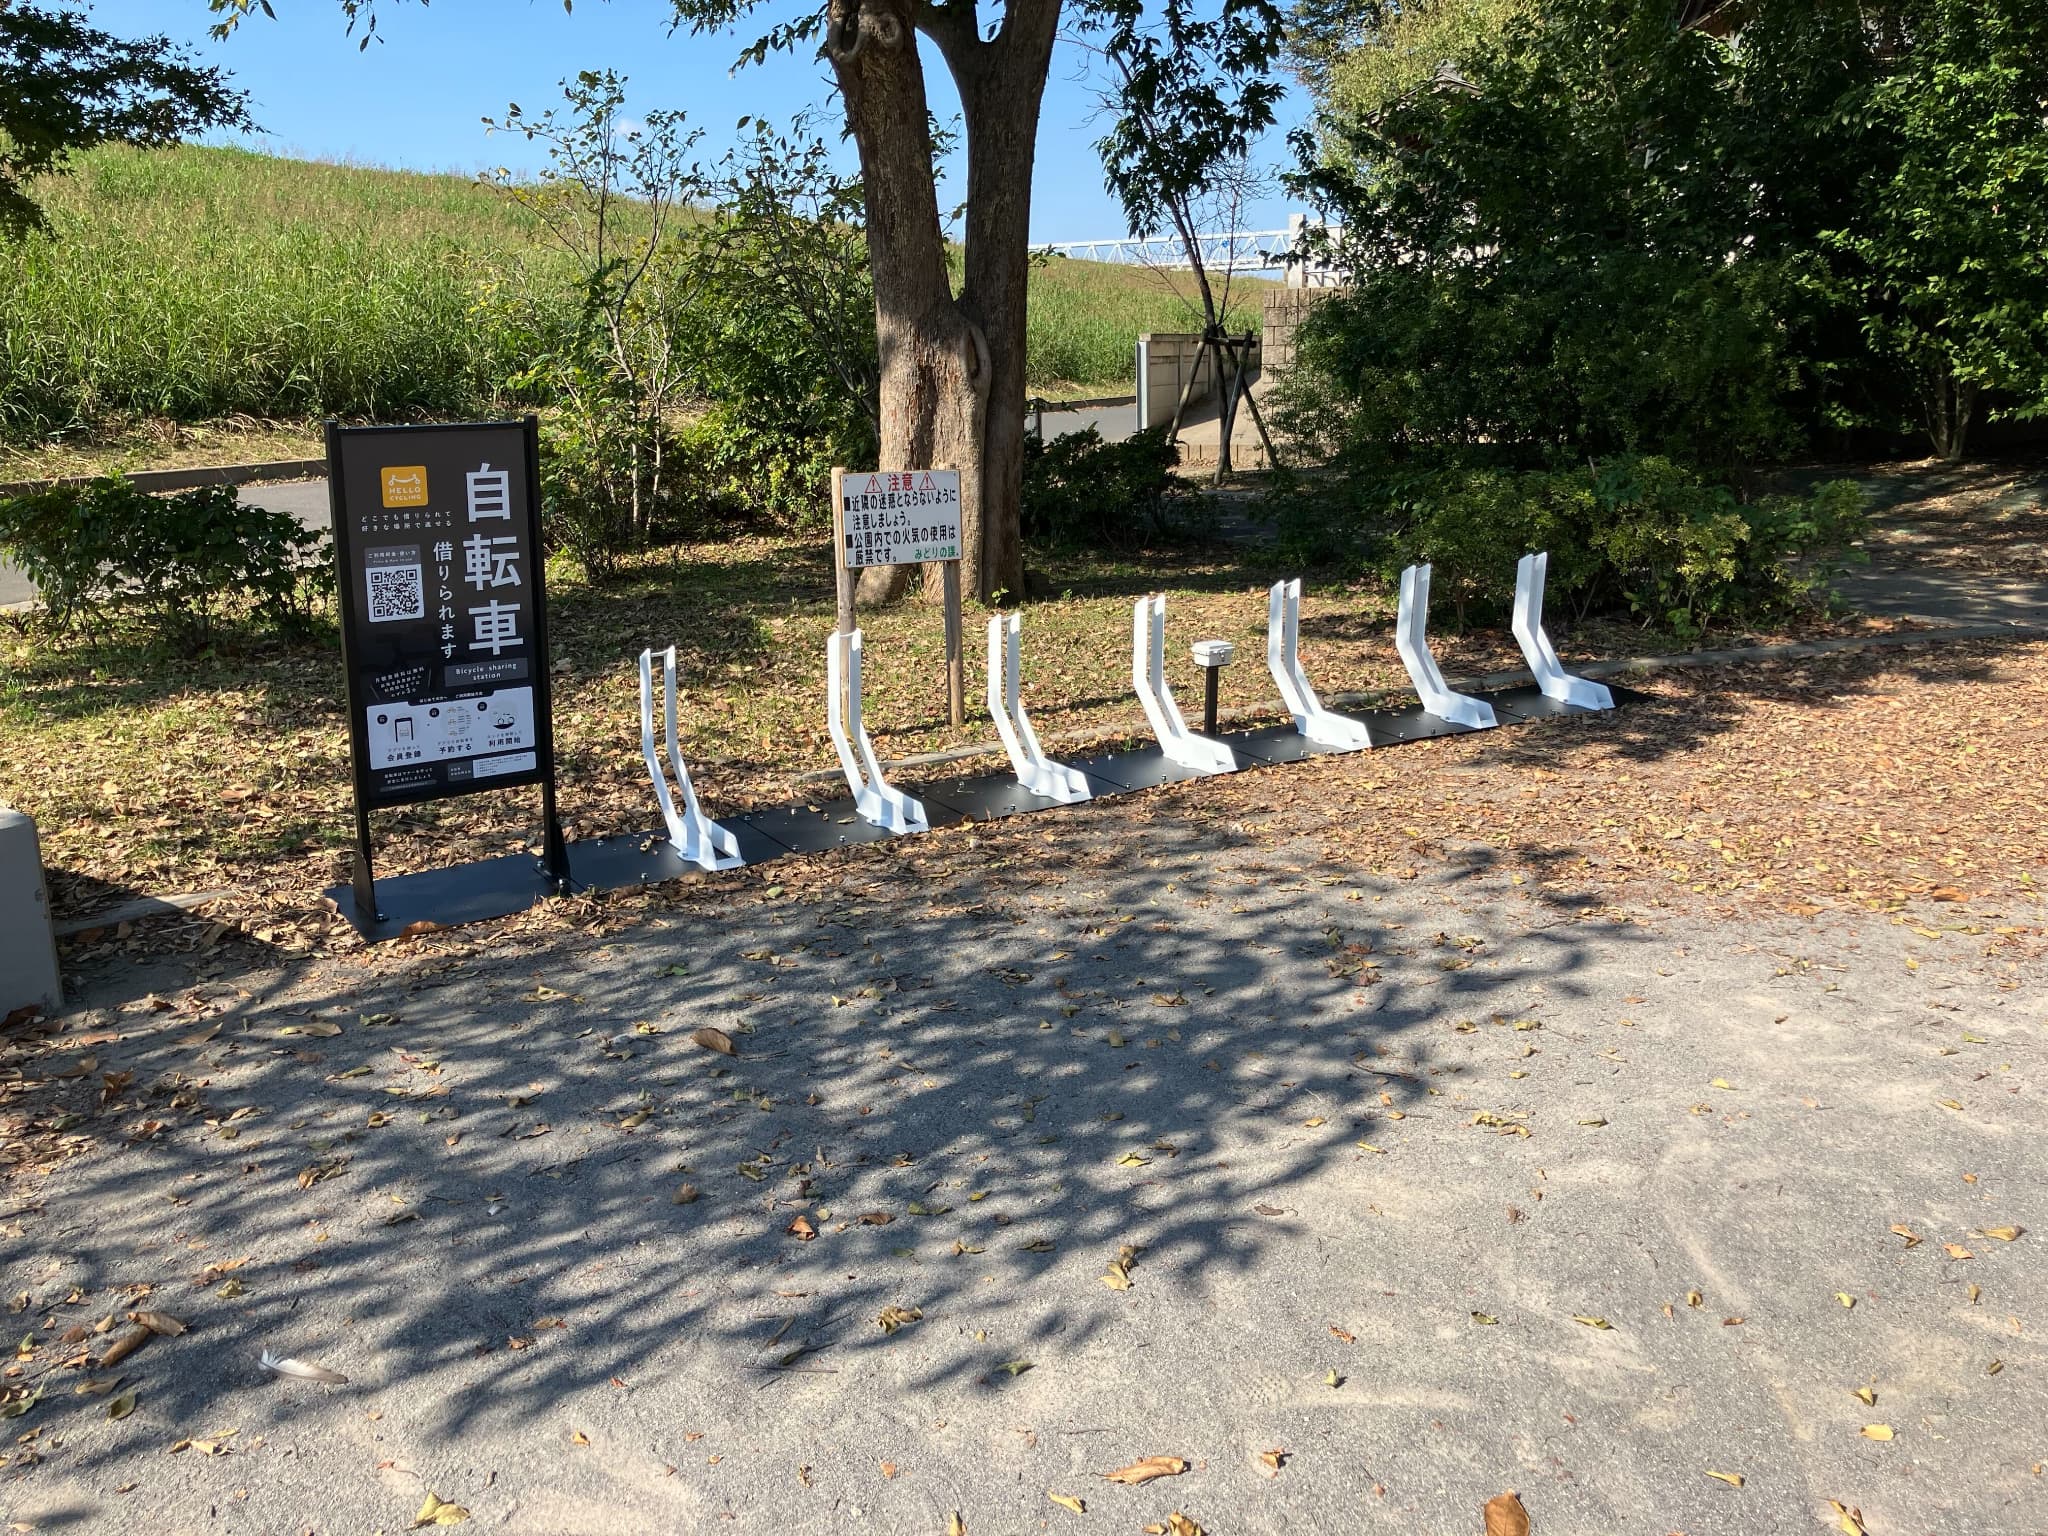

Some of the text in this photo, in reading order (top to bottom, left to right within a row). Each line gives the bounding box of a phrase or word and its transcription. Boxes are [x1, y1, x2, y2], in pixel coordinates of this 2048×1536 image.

[389, 486, 421, 495] HELLO
[888, 473, 914, 492] 注意
[389, 494, 421, 502] CYCLING
[851, 488, 957, 512] 近隣の迷惑とならないように
[853, 511, 911, 531] 注意しましょう。
[854, 524, 956, 549] 公園内での火気の使用は
[463, 462, 524, 656] 自転車
[855, 547, 897, 565] 厳禁です。
[433, 541, 457, 659] 借りられます
[455, 662, 517, 675] Bicycle sharing
[473, 672, 501, 681] station
[439, 744, 472, 755] 予約する
